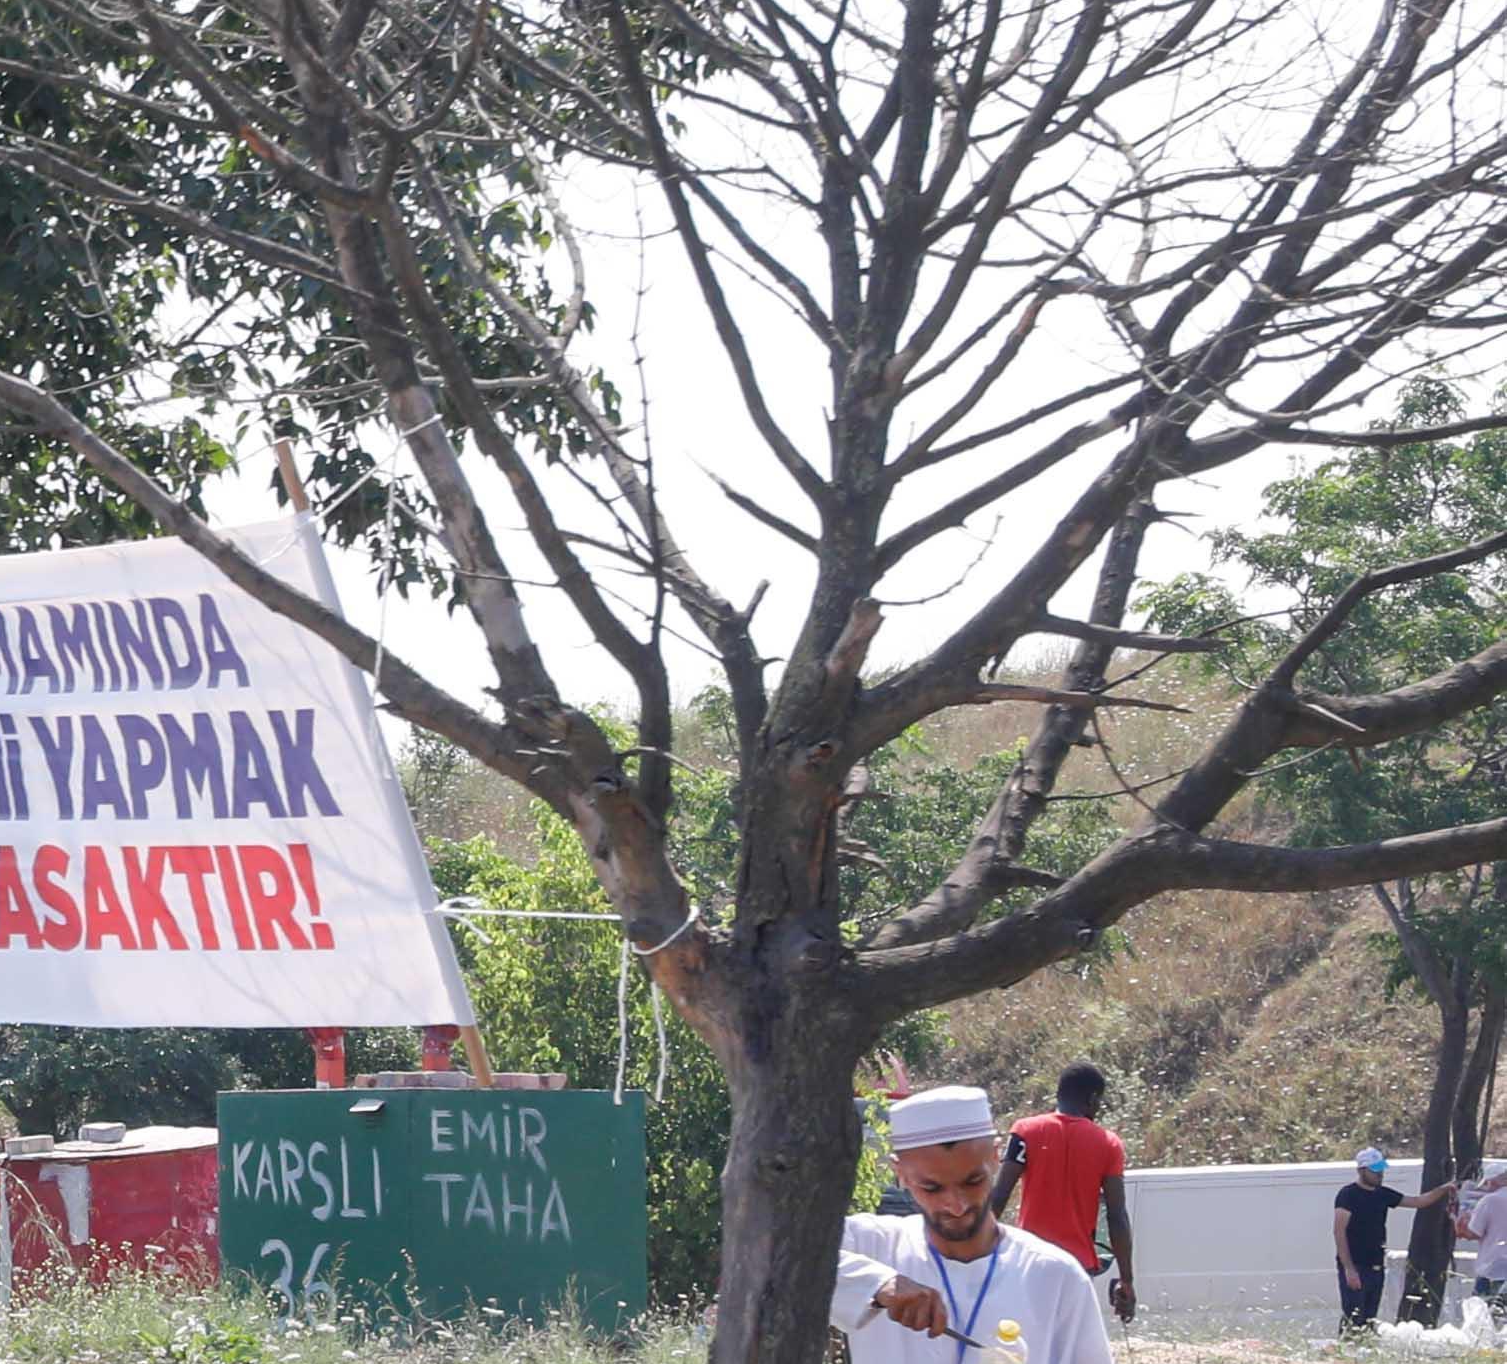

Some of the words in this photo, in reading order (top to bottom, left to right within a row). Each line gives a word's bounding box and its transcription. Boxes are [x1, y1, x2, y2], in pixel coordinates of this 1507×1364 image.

[27, 709, 342, 821] YAPMAK
[230, 1135, 383, 1222] KARSLI
[420, 1170, 573, 1243] TAHA
